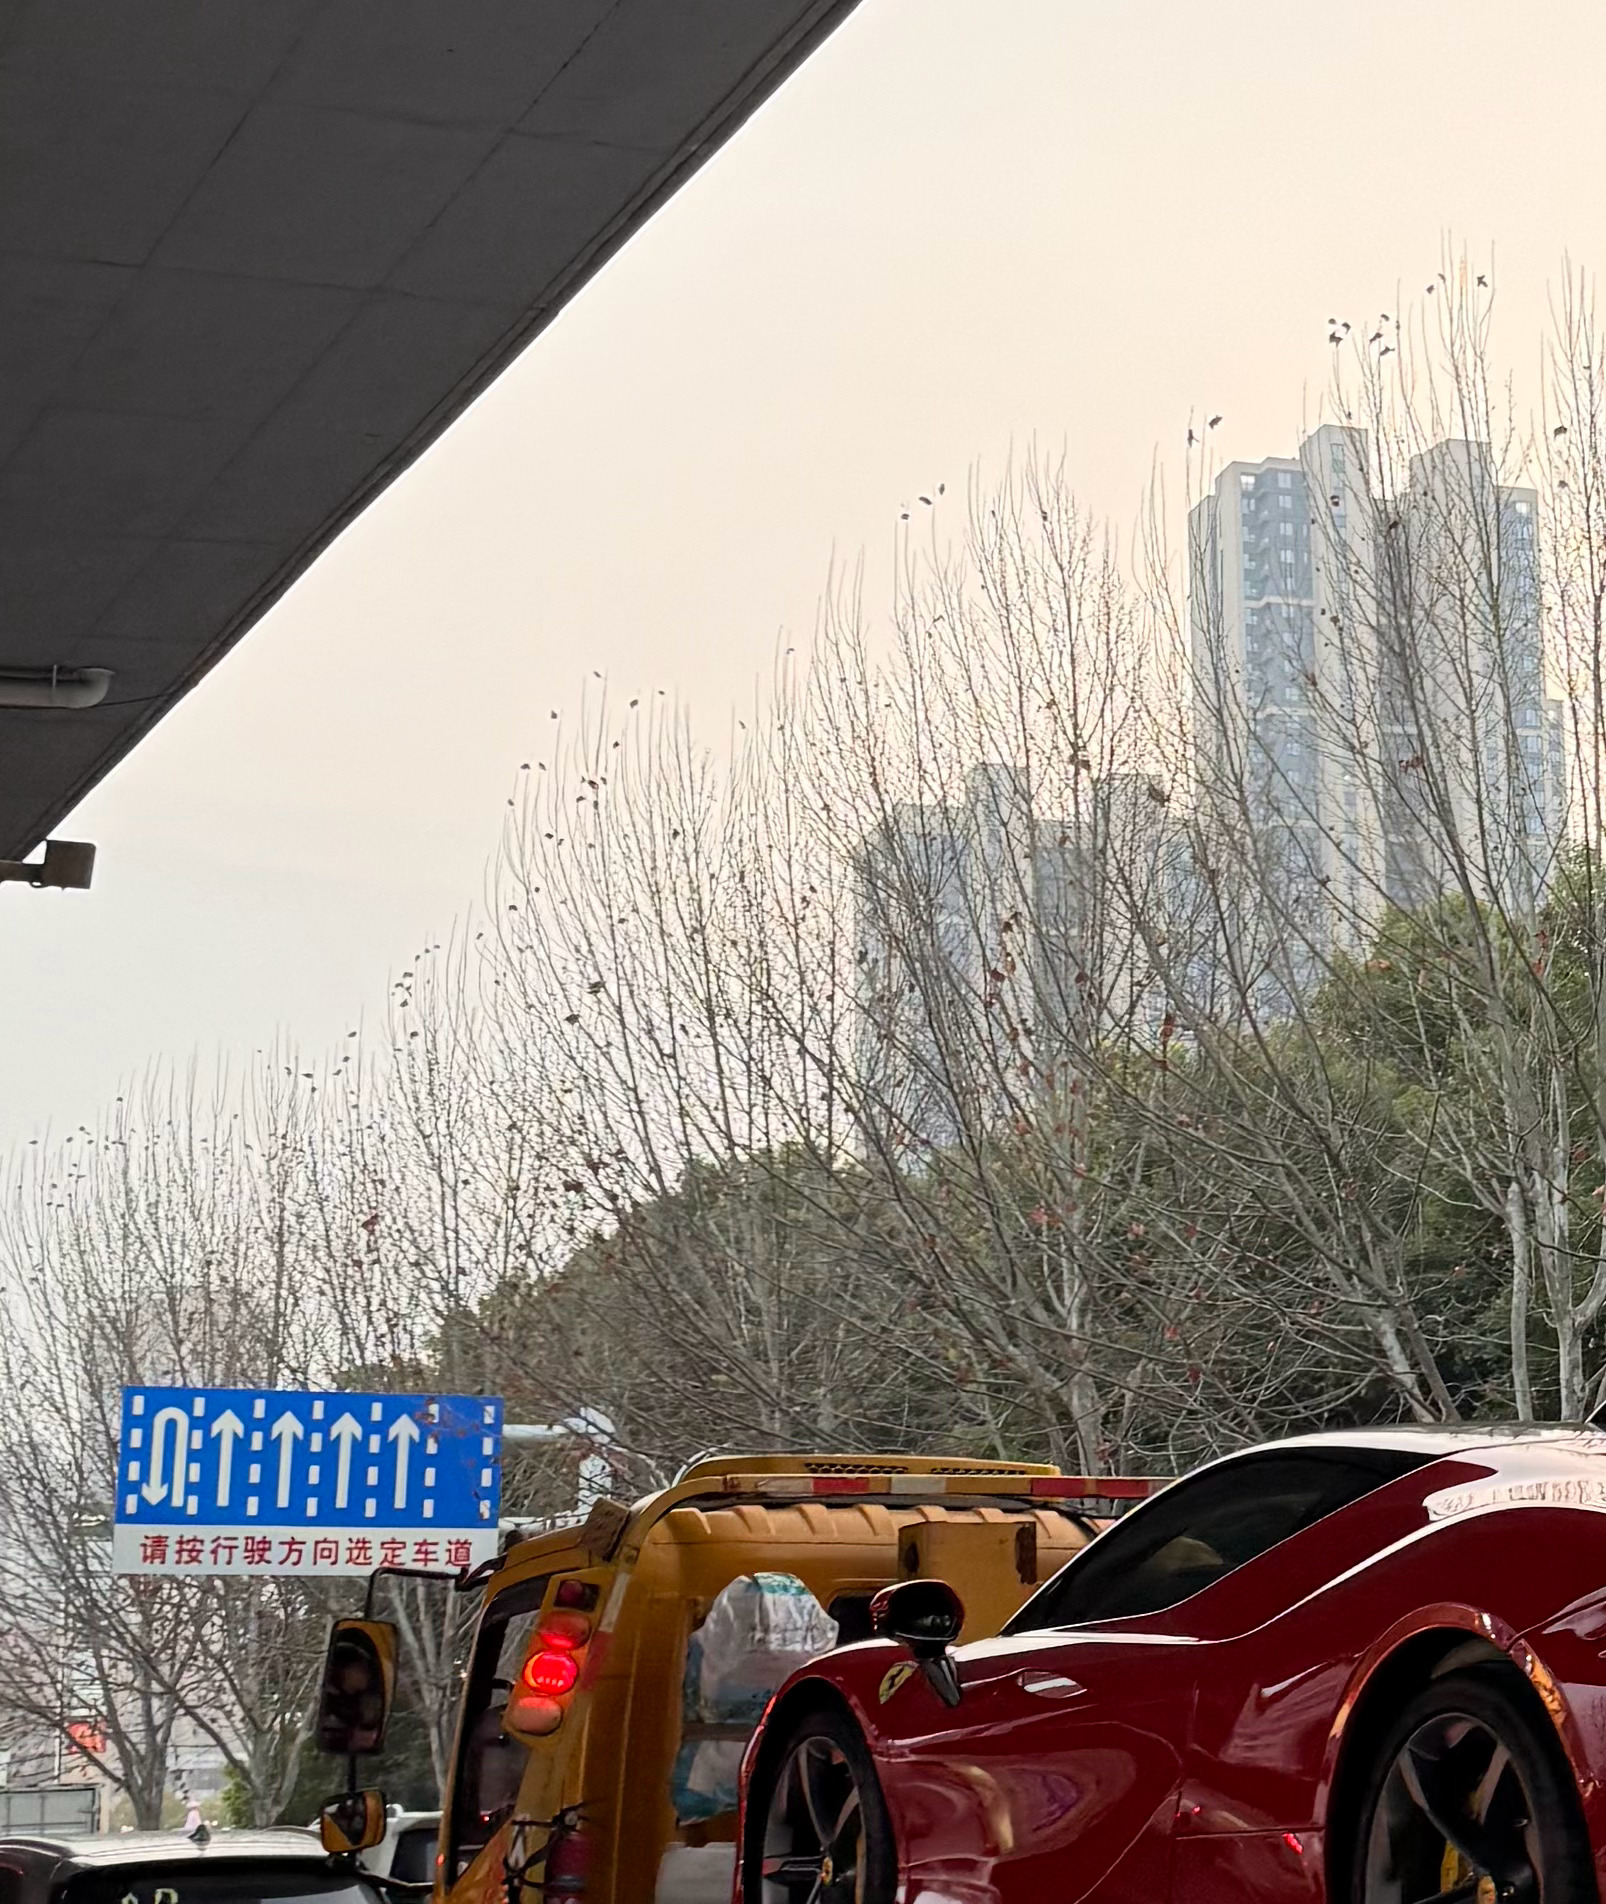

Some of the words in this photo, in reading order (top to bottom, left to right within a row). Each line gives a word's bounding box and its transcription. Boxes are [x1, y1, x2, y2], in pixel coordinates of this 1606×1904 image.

[139, 1534, 474, 1568] 请按行驶方向选定车道
